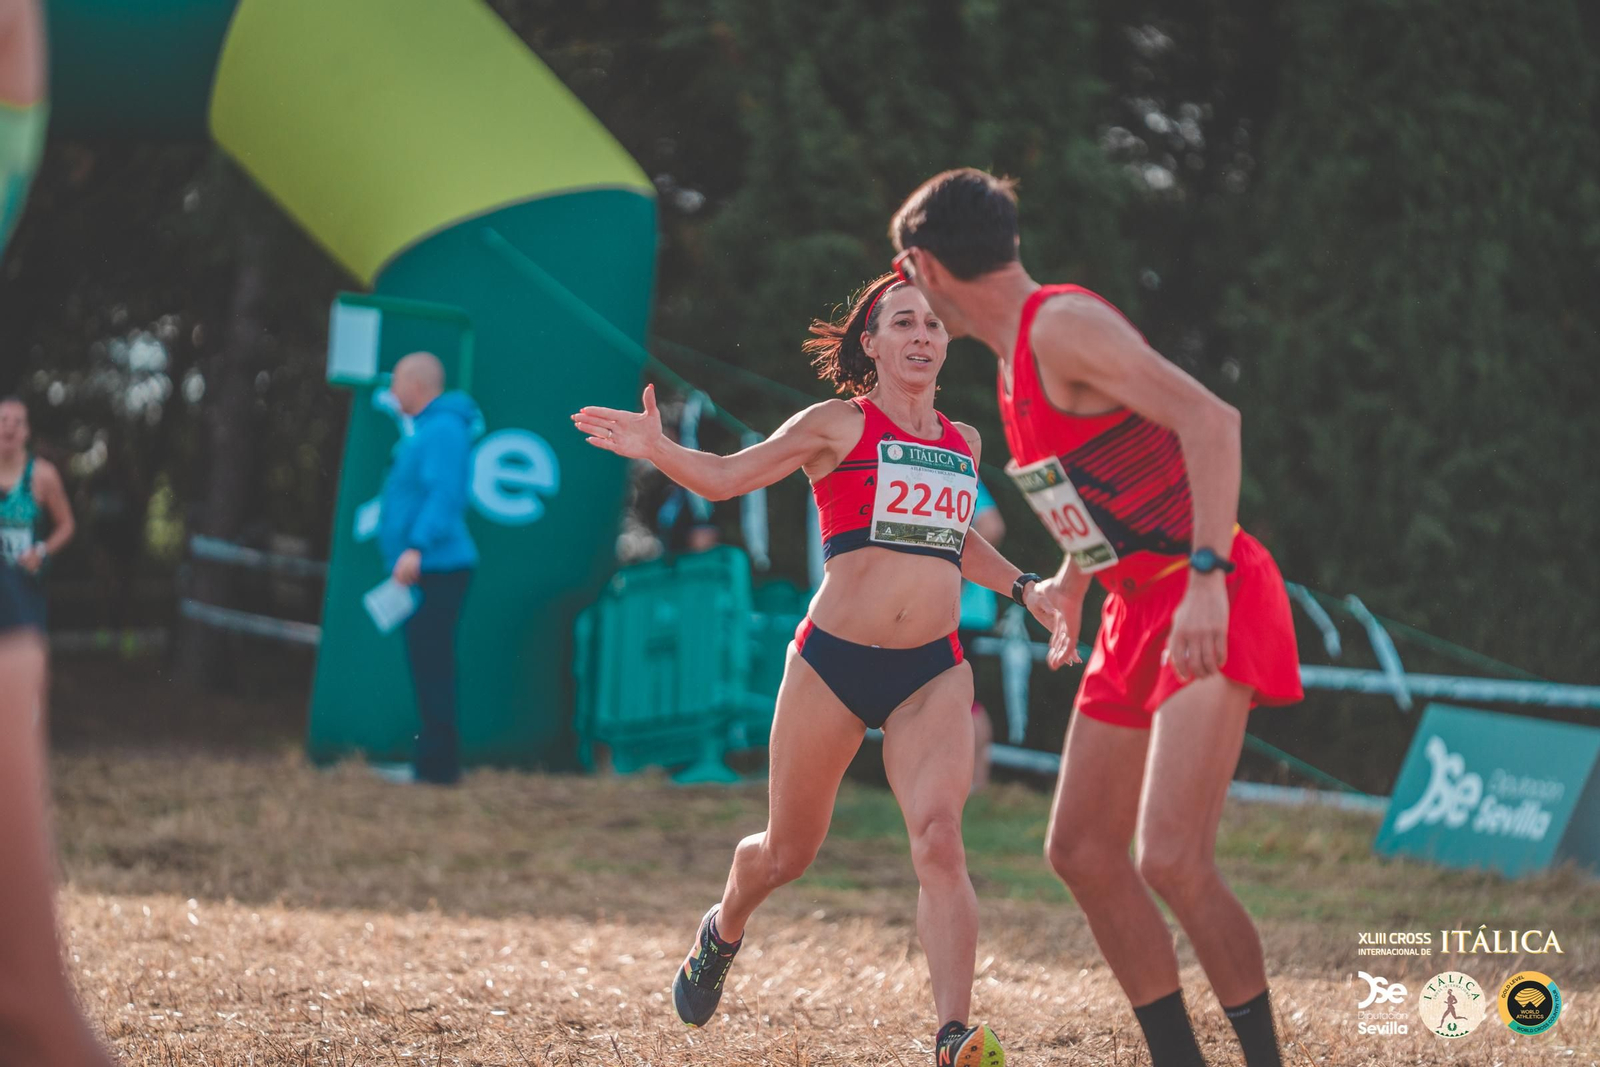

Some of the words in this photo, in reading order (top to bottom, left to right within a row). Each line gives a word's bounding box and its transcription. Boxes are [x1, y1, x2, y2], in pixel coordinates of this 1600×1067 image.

[910, 448, 955, 466] ITÁLICA
[886, 480, 972, 523] 2240
[1472, 793, 1553, 842] Sevilla
